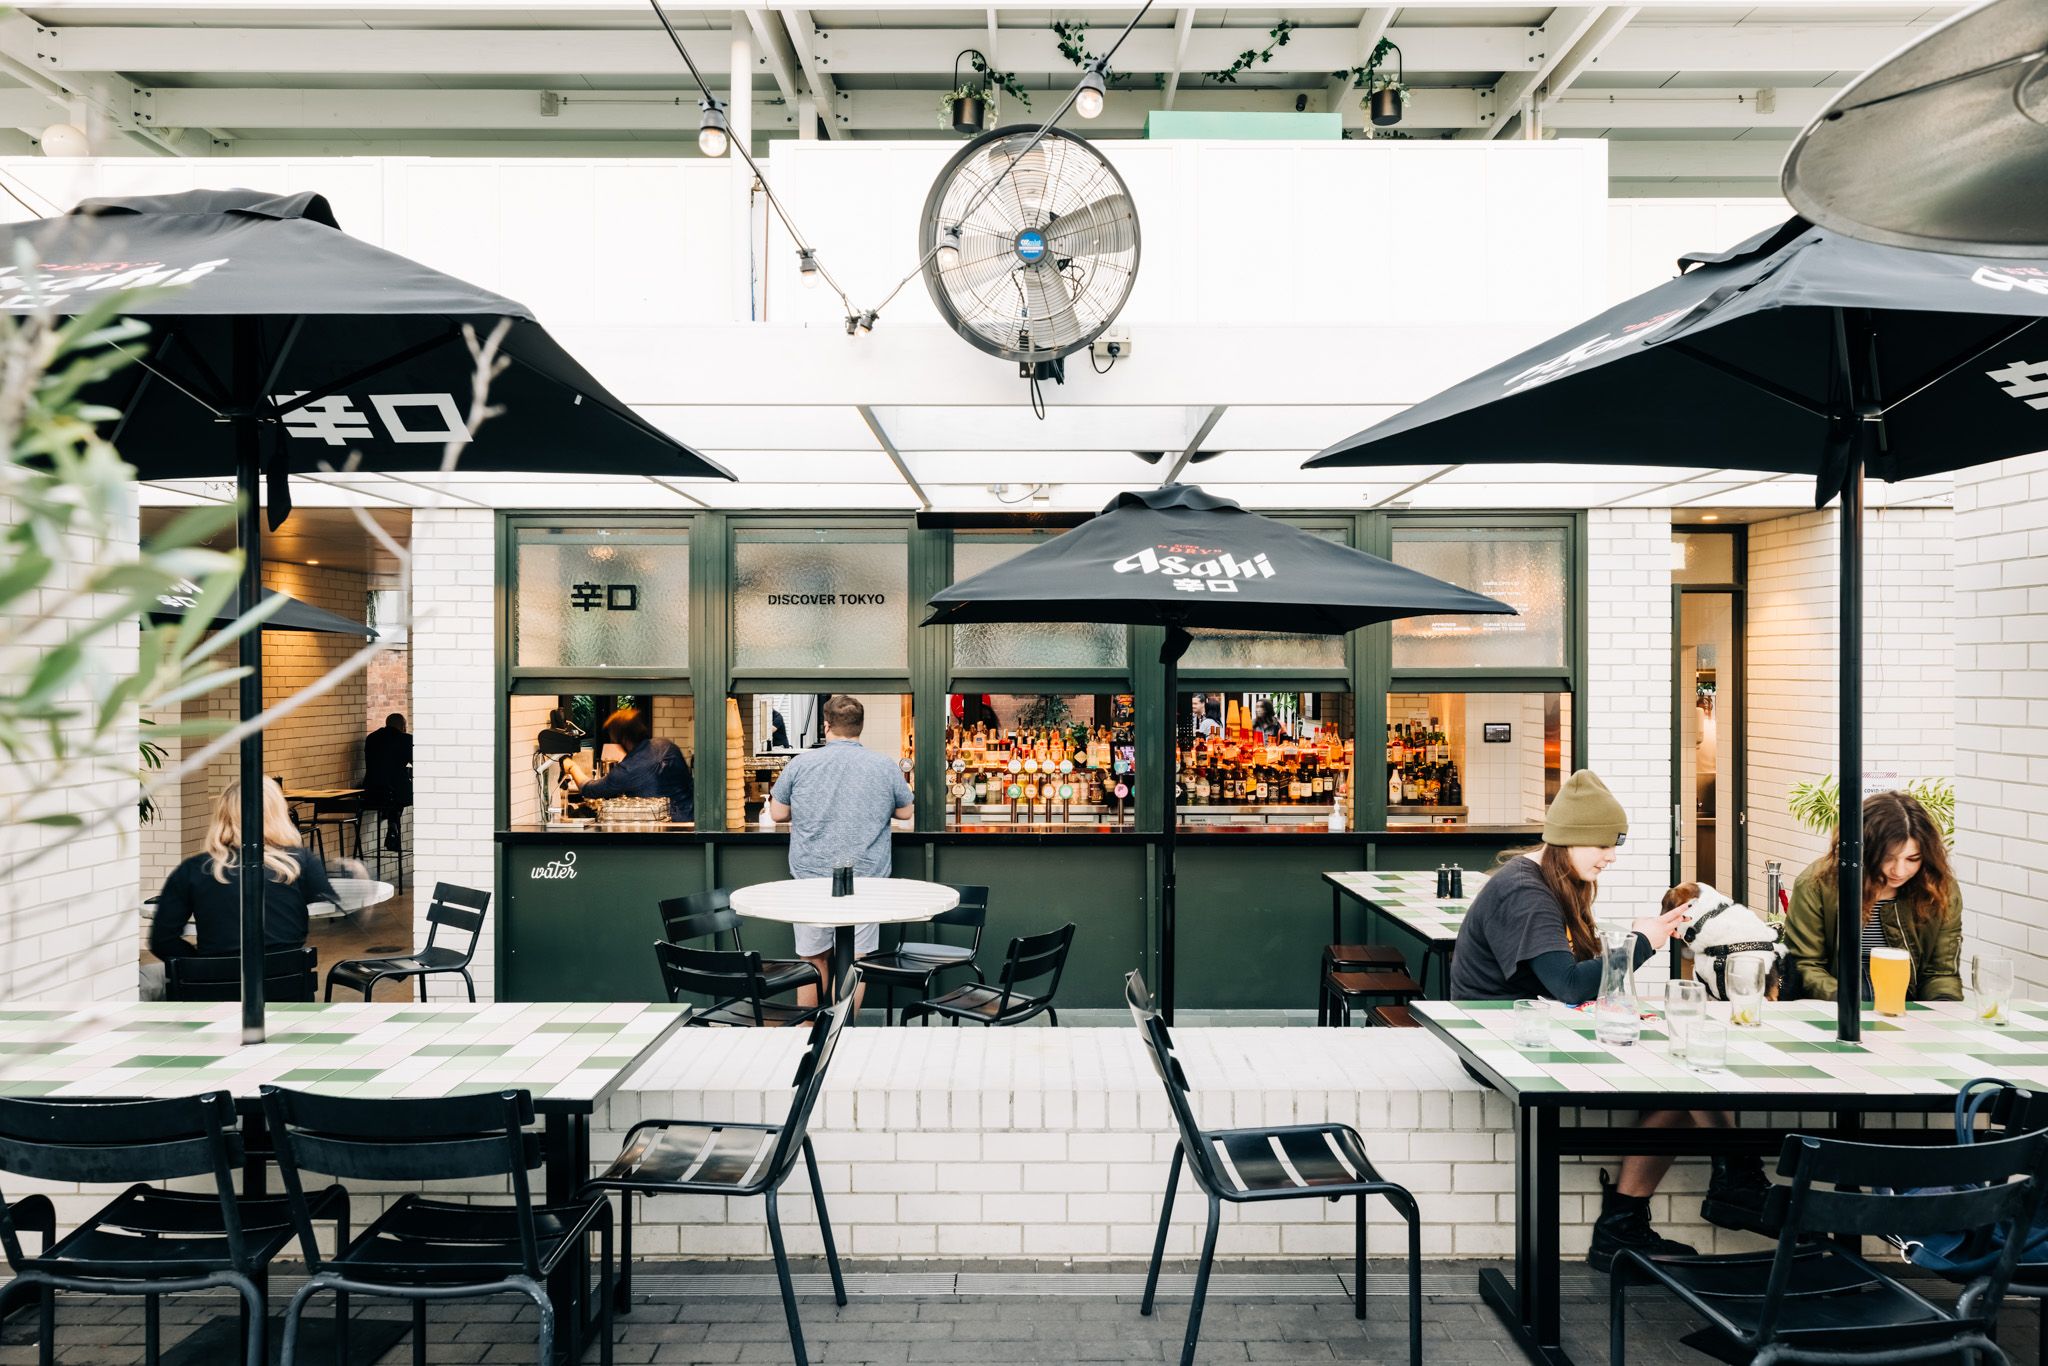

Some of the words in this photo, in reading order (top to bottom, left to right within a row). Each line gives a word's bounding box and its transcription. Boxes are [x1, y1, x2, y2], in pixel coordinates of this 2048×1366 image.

[267, 390, 474, 446] 辛口
[1113, 547, 1276, 578] Asahi
[571, 581, 638, 612] 辛口
[768, 594, 836, 606] DISCOVER
[841, 593, 885, 605] TOKYO
[1173, 578, 1239, 592] 辛口
[531, 851, 578, 879] water
